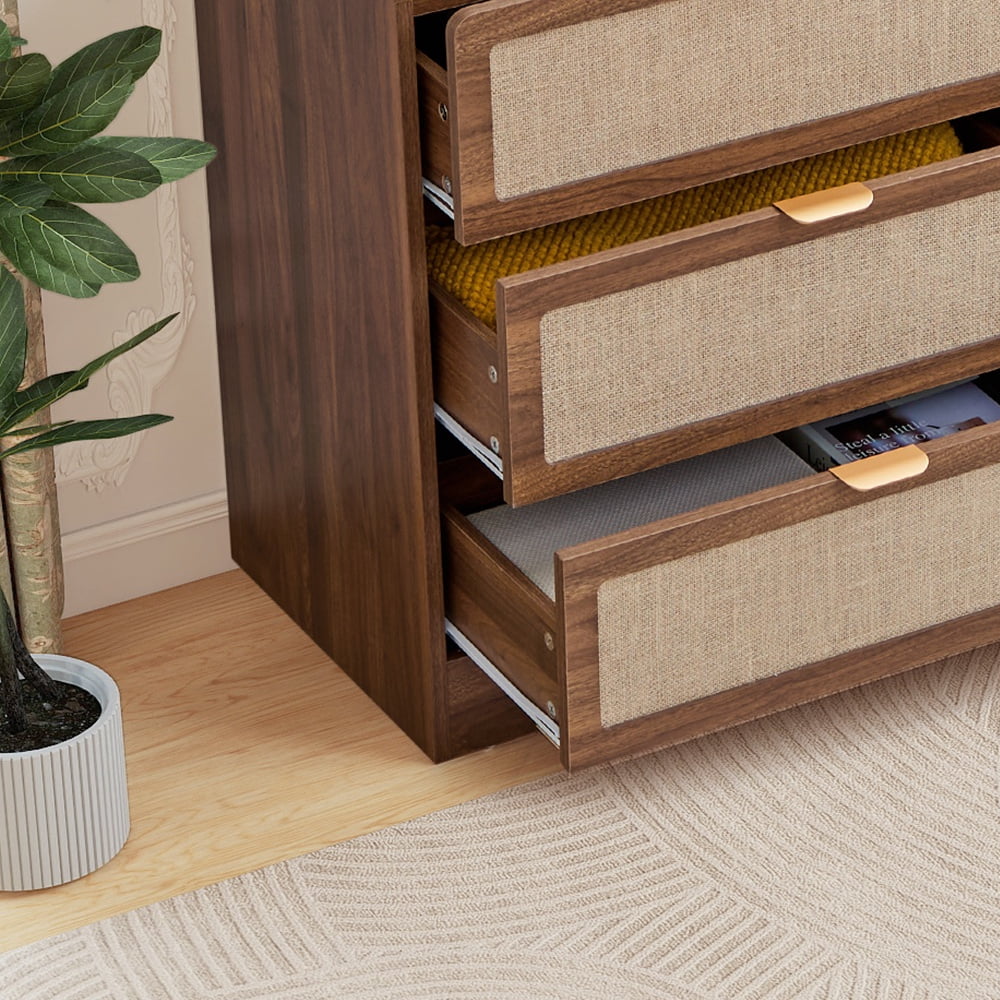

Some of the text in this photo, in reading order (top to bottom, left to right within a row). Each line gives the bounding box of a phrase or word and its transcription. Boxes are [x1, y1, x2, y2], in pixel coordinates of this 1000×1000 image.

[834, 420, 929, 453] Steal a little
